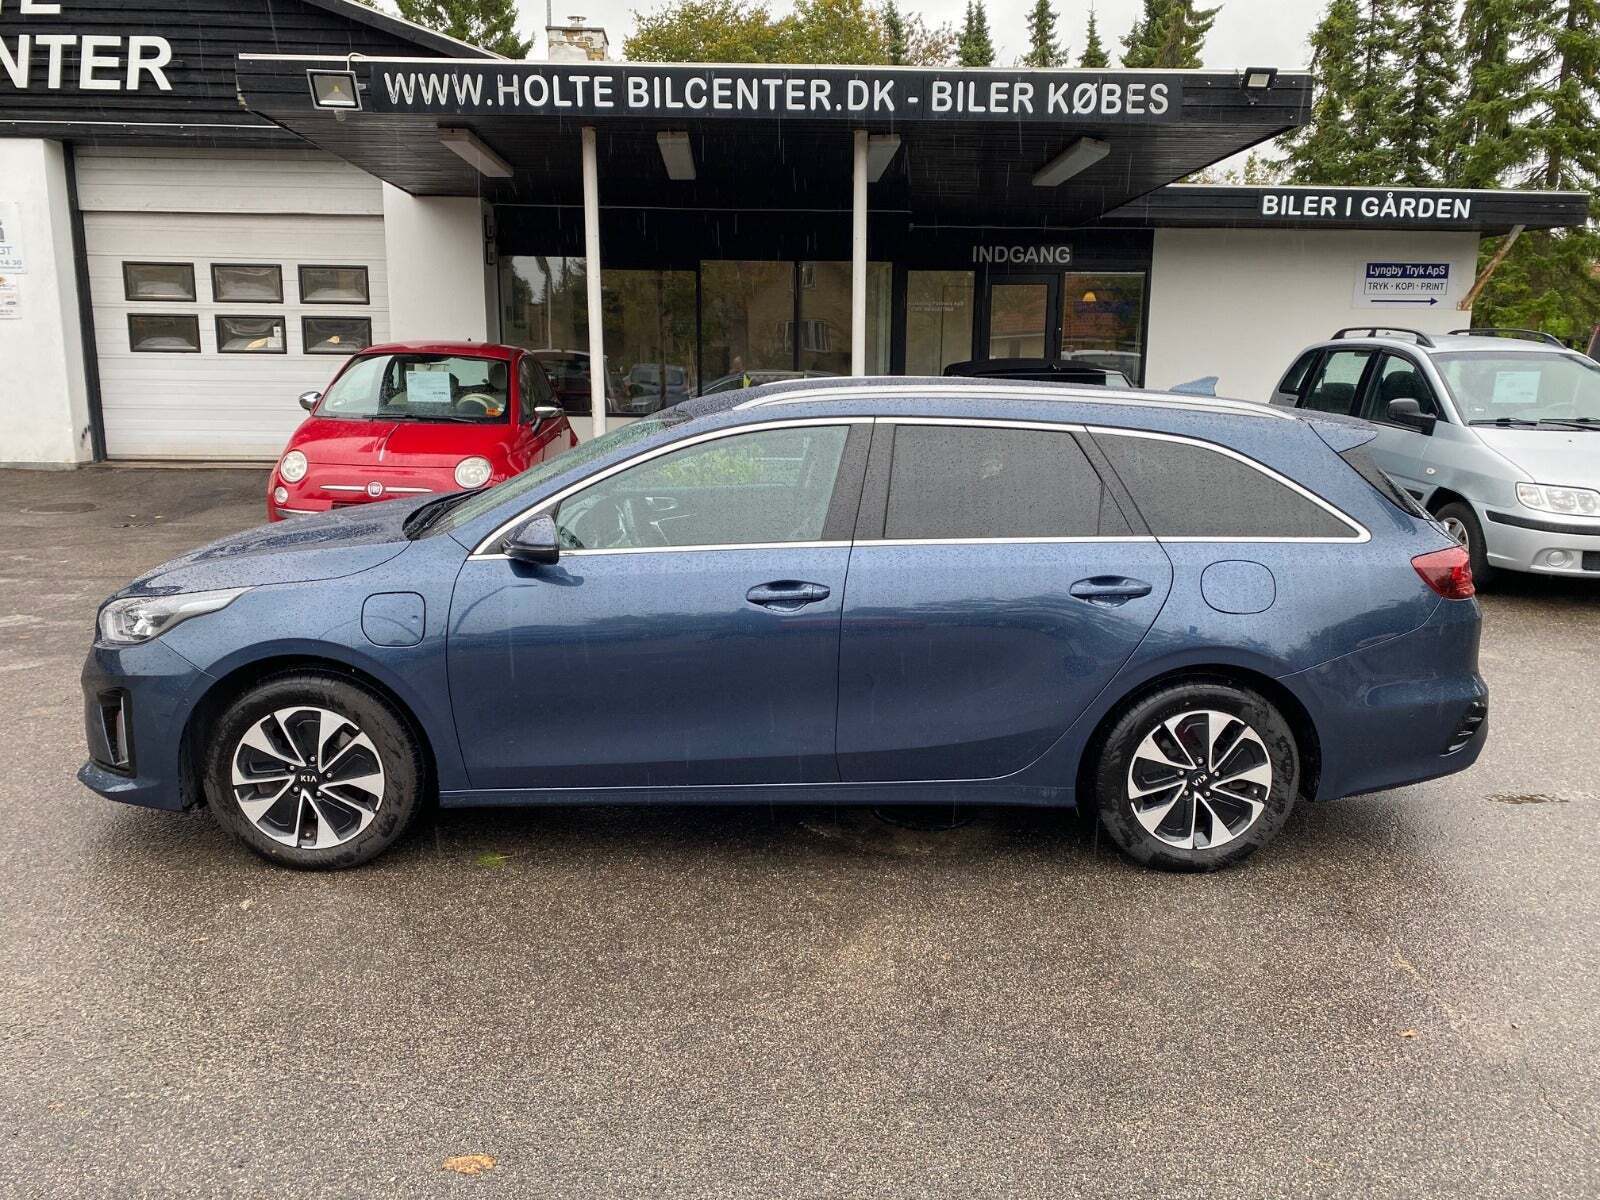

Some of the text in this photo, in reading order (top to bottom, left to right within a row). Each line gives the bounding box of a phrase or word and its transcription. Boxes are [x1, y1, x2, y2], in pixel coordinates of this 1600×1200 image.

[383, 72, 615, 108] WWW.HOLTE
[627, 75, 896, 112] BILCENTER.DK
[931, 81, 1035, 114] BILER
[1047, 82, 1169, 115] KØBES
[1262, 192, 1471, 219] BILER I GÅRDEN
[972, 245, 1071, 264] INDGANG
[1369, 265, 1446, 277] Lyngby Tryk ApS
[1368, 282, 1389, 291] TRYK
[1395, 282, 1415, 291] KOPI
[1420, 282, 1445, 291] PRINT
[1191, 774, 1208, 786] KIA
